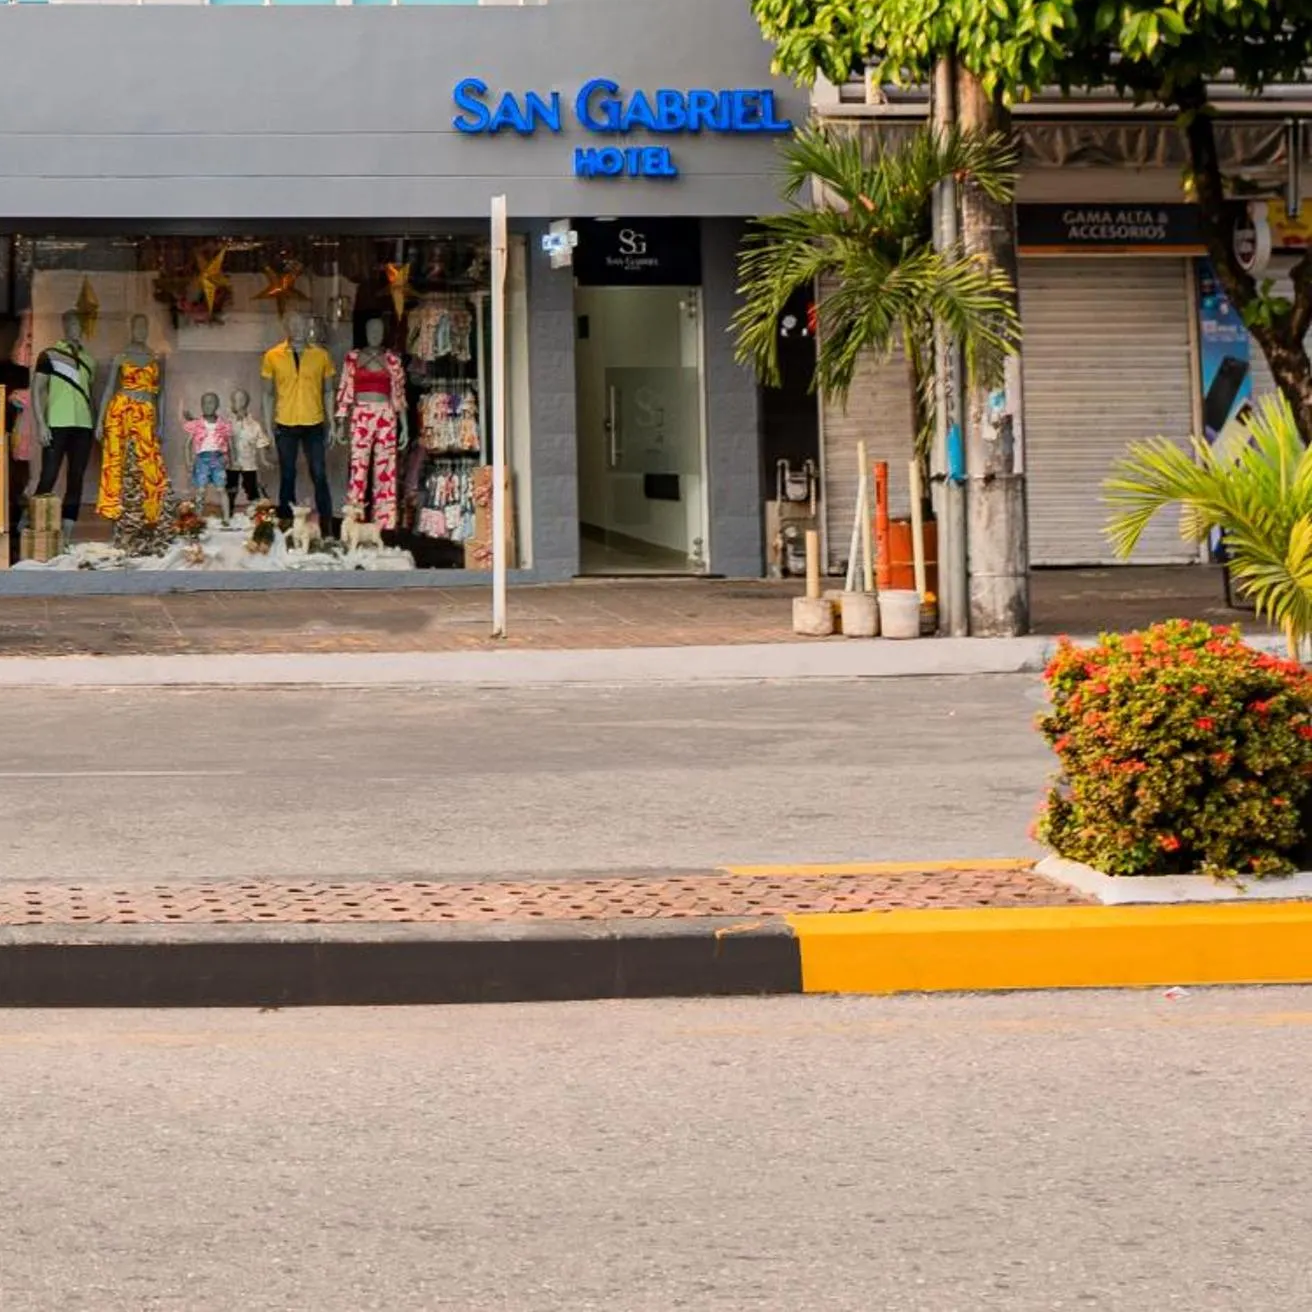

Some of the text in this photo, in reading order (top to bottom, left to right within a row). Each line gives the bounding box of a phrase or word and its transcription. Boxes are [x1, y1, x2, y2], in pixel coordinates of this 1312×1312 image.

[452, 77, 793, 134] SAN GABRIEL
[573, 145, 679, 177] HOTEL
[1062, 210, 1112, 224] GAMA
[1115, 210, 1154, 224] ALTA
[1068, 226, 1166, 239] ACCESORIOS
